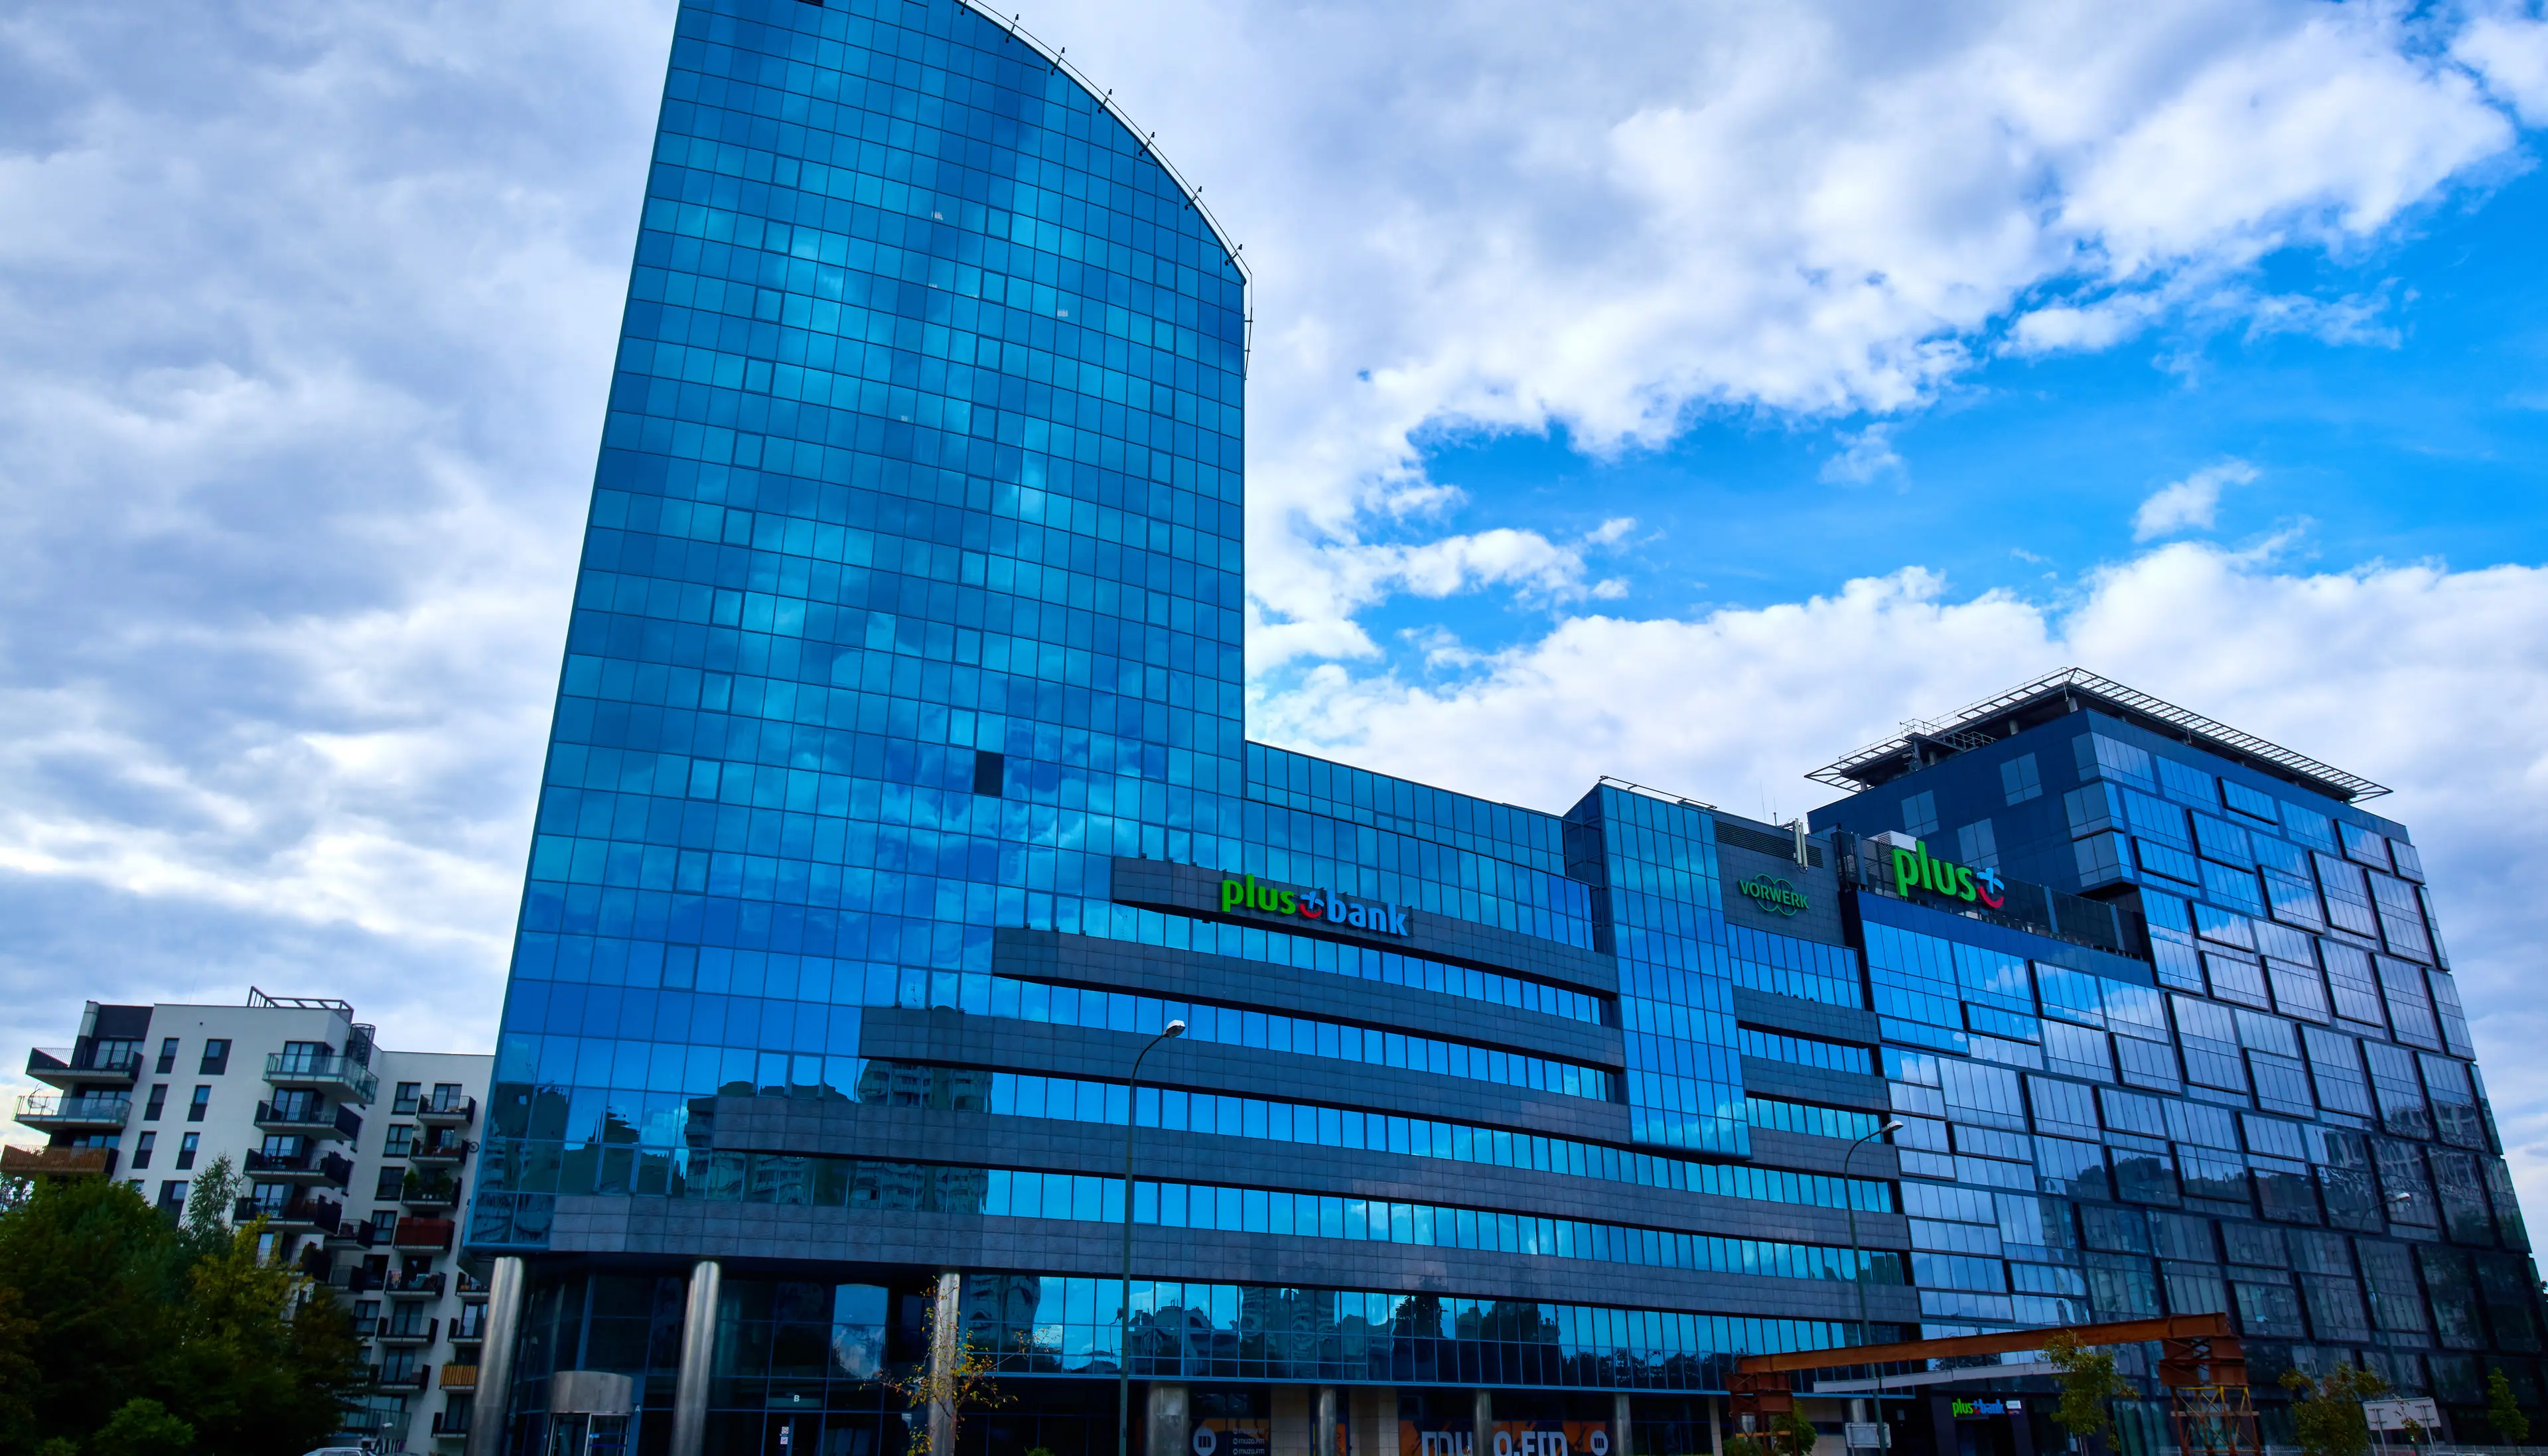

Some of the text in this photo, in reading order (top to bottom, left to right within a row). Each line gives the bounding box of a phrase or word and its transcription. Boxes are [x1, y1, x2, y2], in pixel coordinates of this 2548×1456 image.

[1892, 840, 1977, 901] plus
[1222, 874, 1409, 937] plus bank
[1738, 880, 1811, 910] VORWERK
[1952, 1398, 2005, 1418] plus bank
